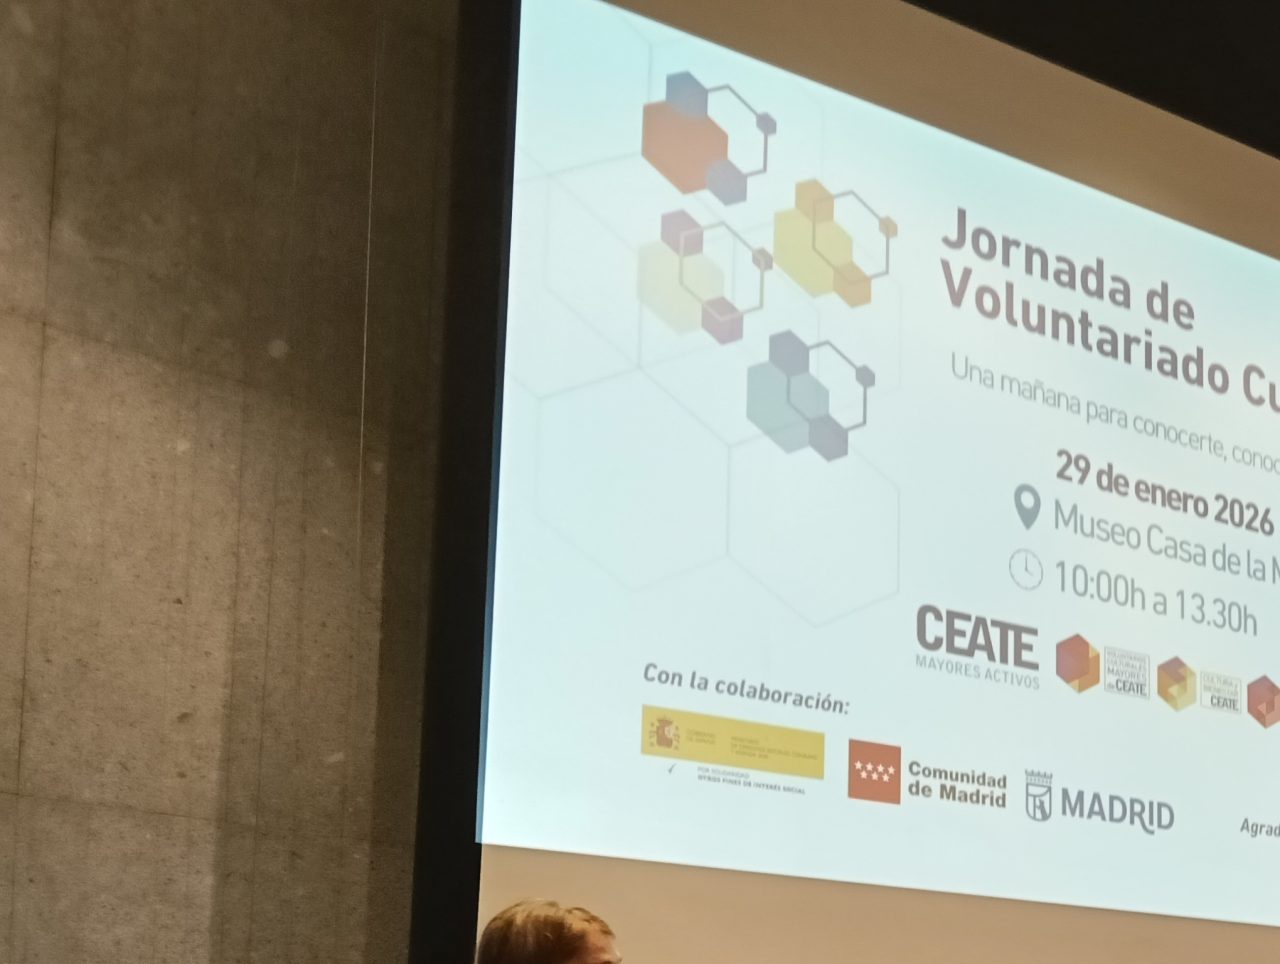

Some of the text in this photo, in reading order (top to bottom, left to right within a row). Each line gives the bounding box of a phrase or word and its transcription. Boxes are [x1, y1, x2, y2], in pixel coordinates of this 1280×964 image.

[942, 207, 1195, 331] Jornada de
[941, 258, 1229, 395] Voluntariado
[951, 350, 995, 389] Una
[1001, 372, 1081, 415] mañana
[1087, 397, 1128, 430] para
[1133, 411, 1227, 462] conocerte,
[1056, 449, 1275, 536] 29 de enero 2026
[1054, 498, 1141, 550] Museo
[1147, 524, 1206, 568] Casa
[1212, 542, 1241, 575] de
[1246, 549, 1266, 581] la
[1056, 560, 1258, 636] 10:00h a 13.30h
[916, 604, 1039, 670] CEATE
[643, 663, 850, 715] Con la colaboración:
[915, 653, 1040, 690] MAYORES ACTIVOS
[1115, 679, 1147, 697] CEATE
[1210, 695, 1239, 711] CEATE
[908, 760, 1007, 789] Comunidad
[908, 780, 1007, 809] de Madrid
[1061, 787, 1175, 835] MADRID
